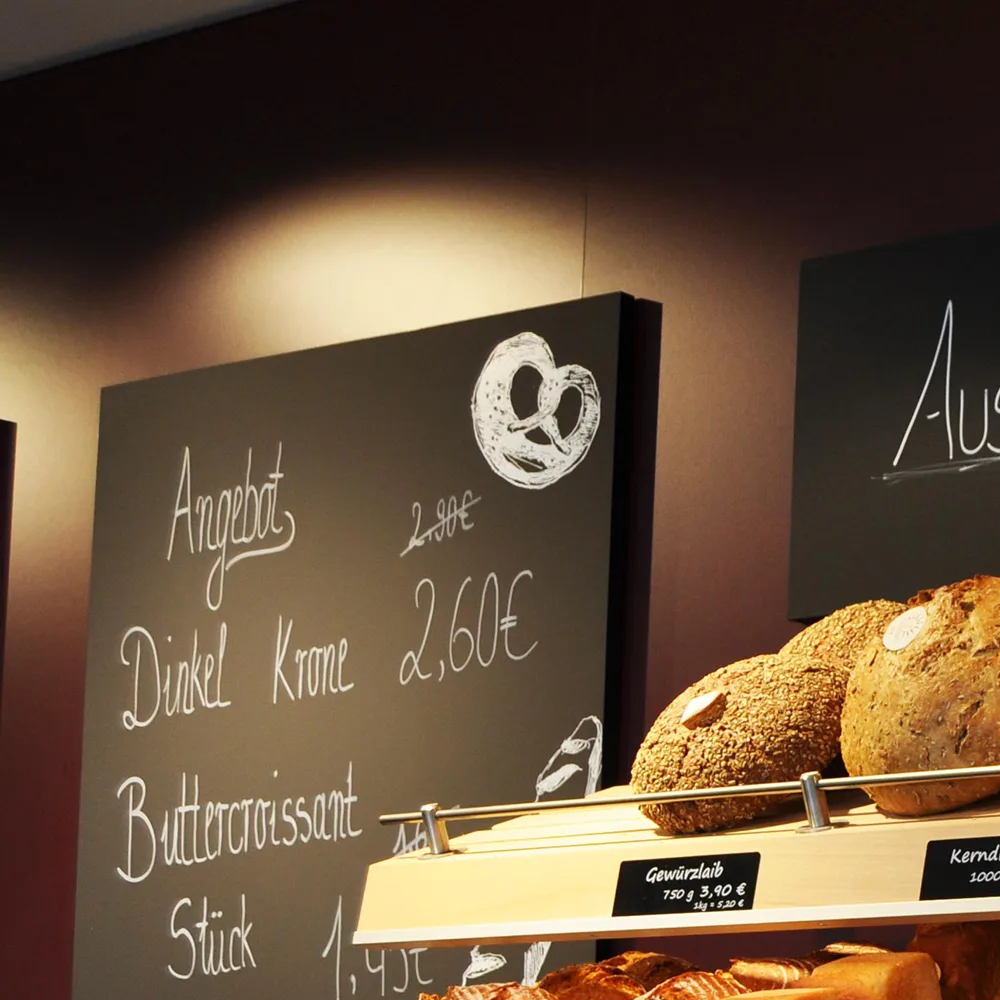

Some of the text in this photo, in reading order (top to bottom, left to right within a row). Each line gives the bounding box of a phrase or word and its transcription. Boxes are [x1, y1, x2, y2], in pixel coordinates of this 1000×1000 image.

[167, 441, 294, 611] Angebot
[120, 622, 231, 731] Dinkel
[273, 615, 354, 704] Krone
[116, 761, 362, 883] Buttercroissant
[646, 861, 724, 883] Gewürzlaib
[663, 882, 747, 902] 750 g 3,90 €
[717, 900, 736, 909] 5,20
[168, 894, 256, 979] Stück
